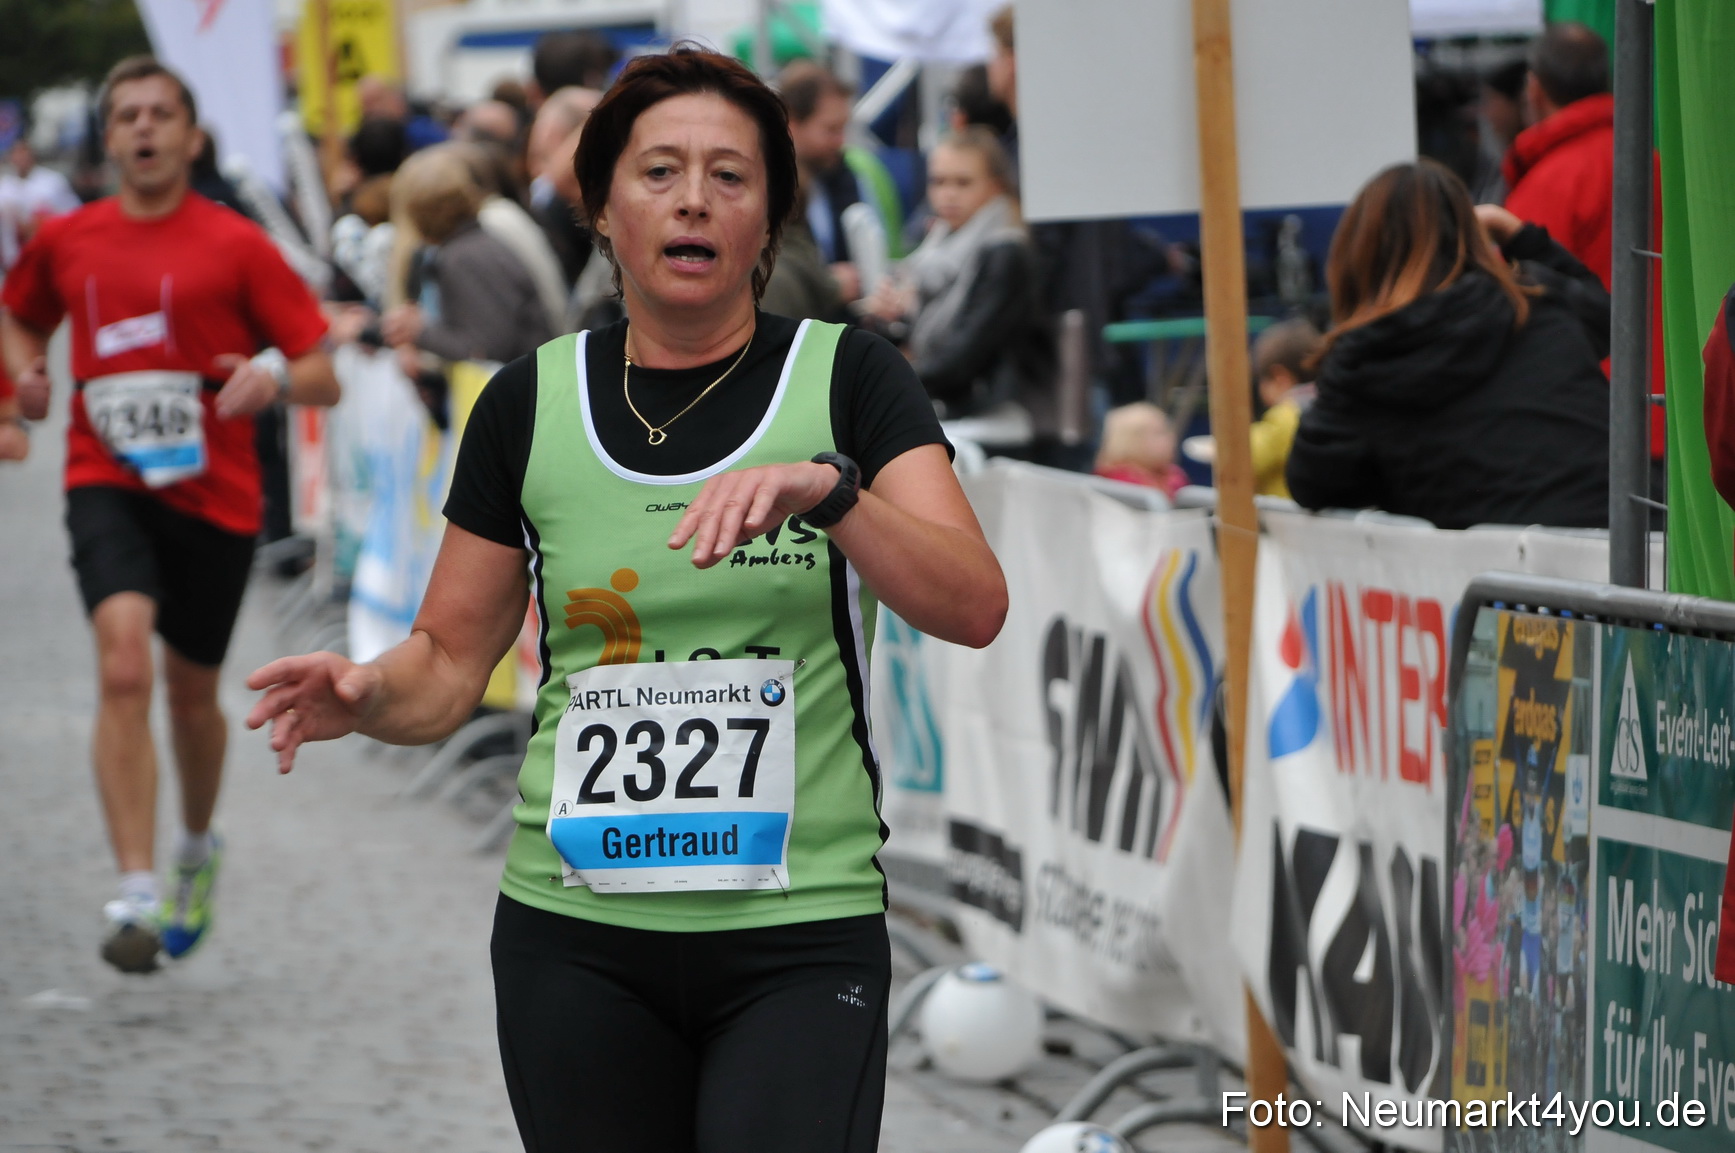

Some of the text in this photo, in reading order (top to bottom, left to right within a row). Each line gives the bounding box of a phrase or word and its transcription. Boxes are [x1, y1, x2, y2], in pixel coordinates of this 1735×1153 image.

[730, 548, 816, 570] Amberg
[565, 684, 751, 713] PARTL Neumarkt
[576, 717, 770, 805] 2327
[559, 803, 568, 815] A
[602, 824, 739, 860] Gertraud
[1607, 875, 1676, 975] Mehr
[1604, 1000, 1646, 1099] für
[1652, 1015, 1684, 1112] Ihr
